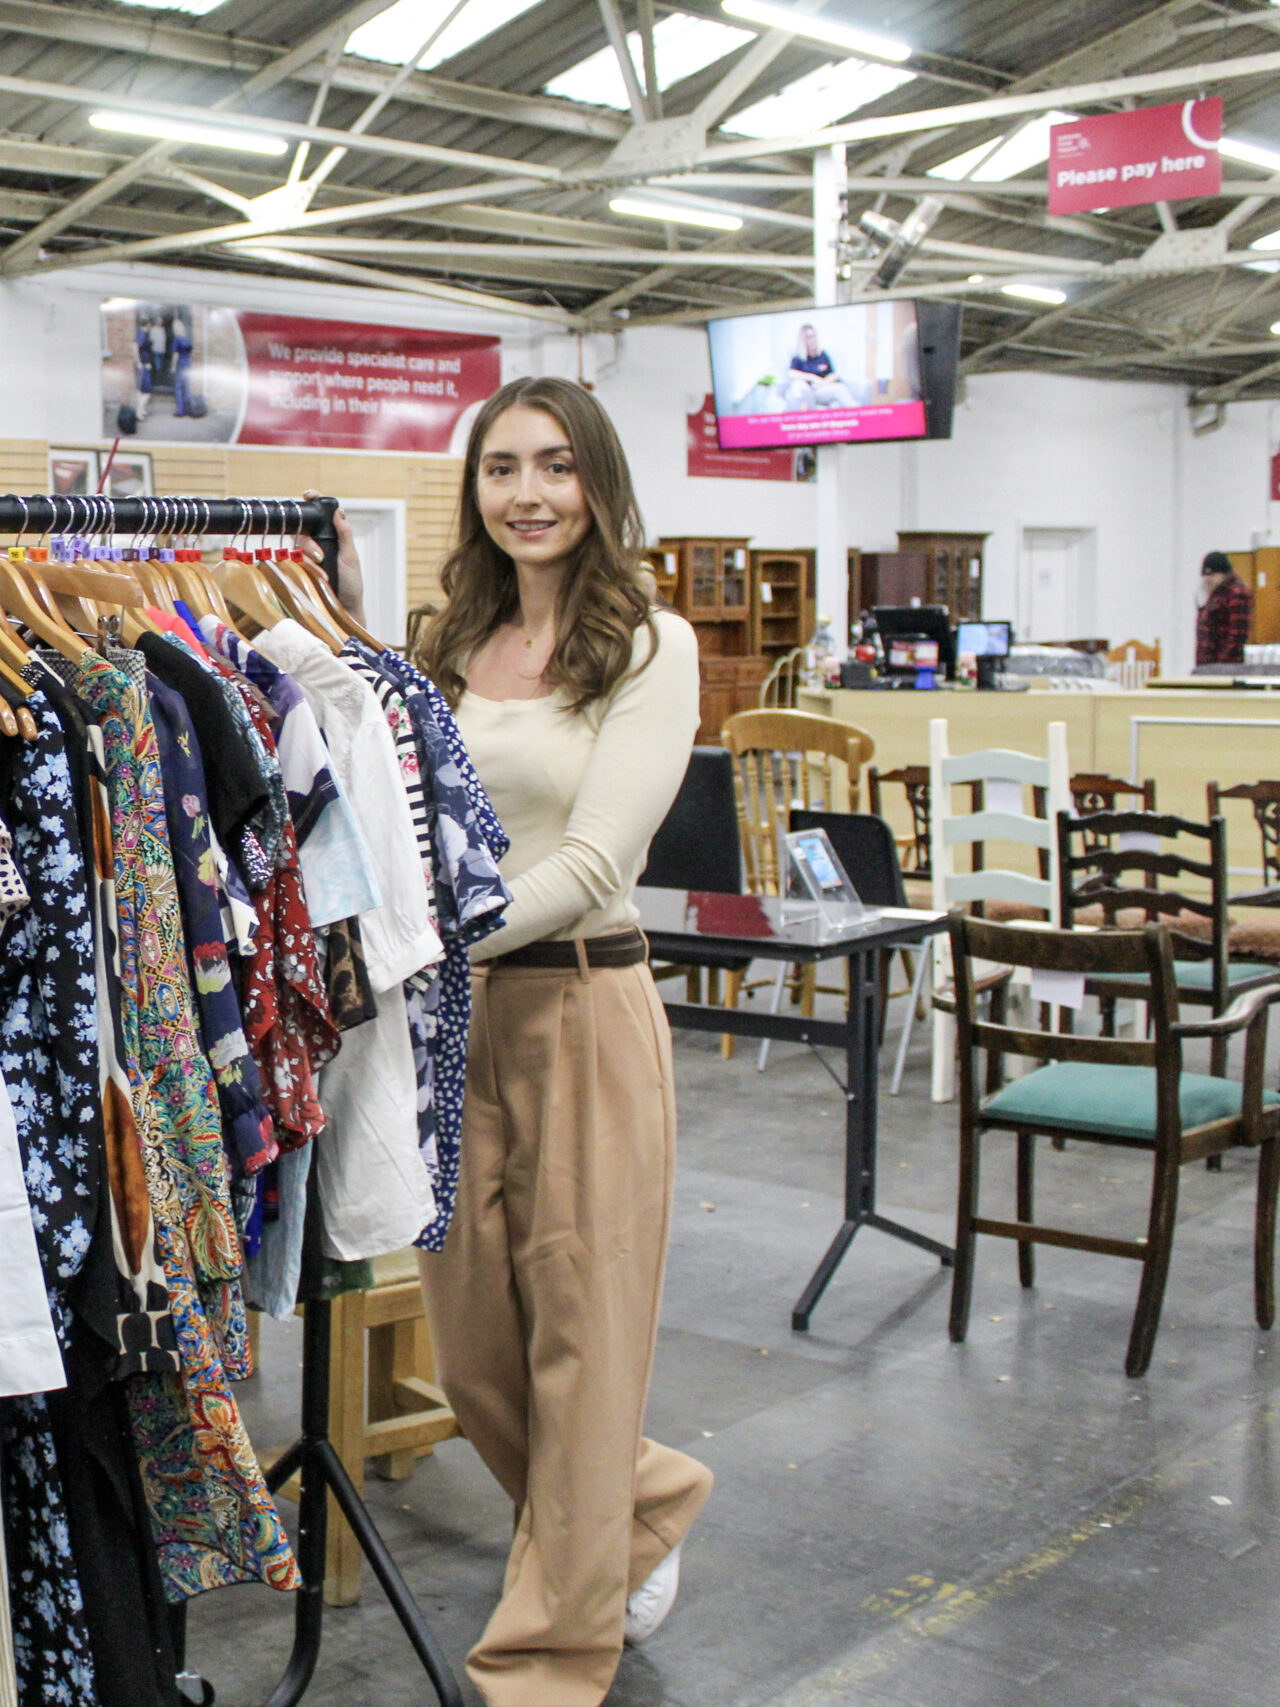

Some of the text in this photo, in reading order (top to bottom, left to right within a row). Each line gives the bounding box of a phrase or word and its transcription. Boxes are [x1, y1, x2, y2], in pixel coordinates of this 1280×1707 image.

[1057, 154, 1207, 187] Please pay here
[268, 342, 461, 373] We provide specialist care and
[269, 370, 459, 397] support where people need it,
[269, 394, 330, 412] including
[333, 395, 346, 409] in
[348, 396, 379, 411] their
